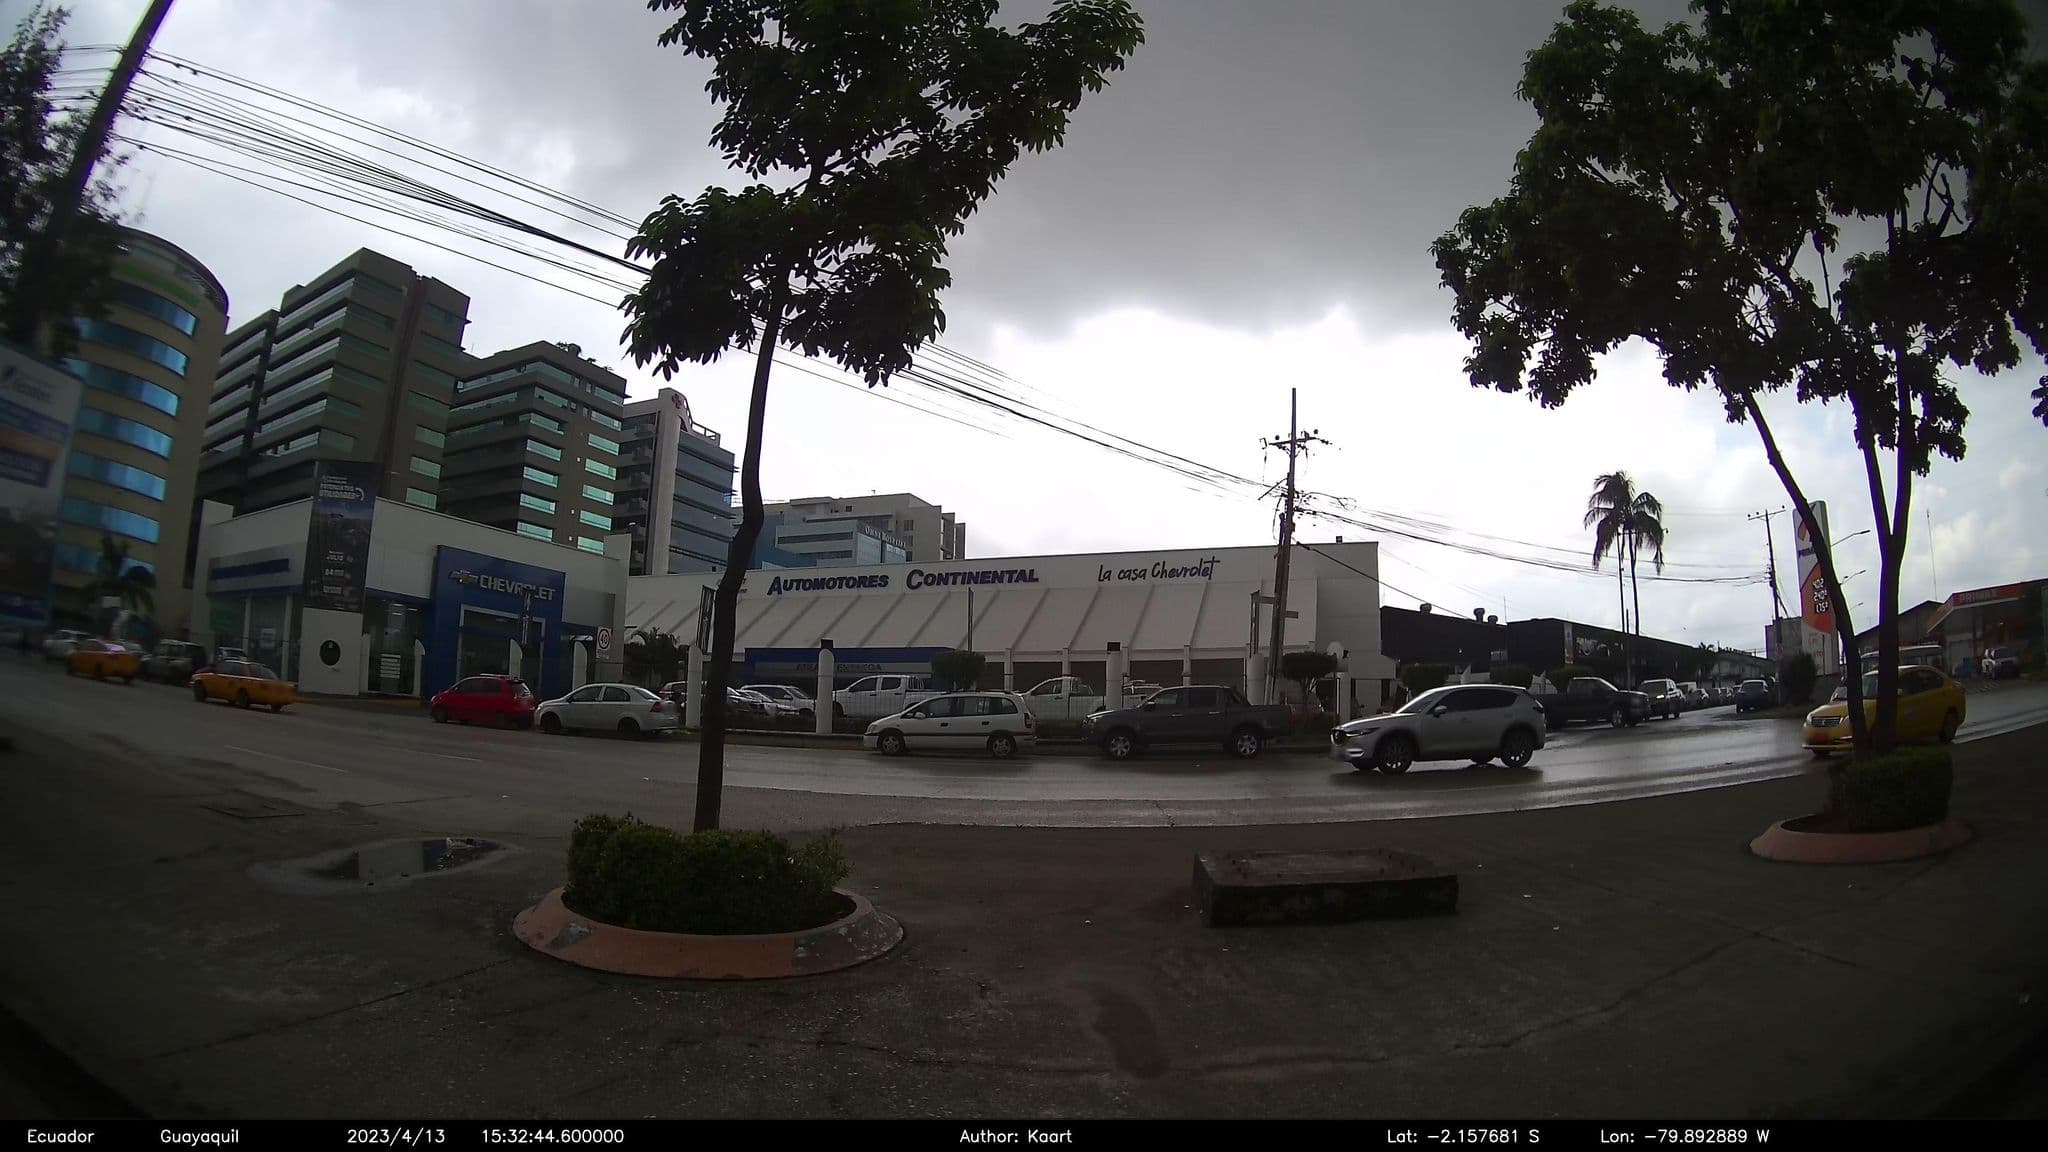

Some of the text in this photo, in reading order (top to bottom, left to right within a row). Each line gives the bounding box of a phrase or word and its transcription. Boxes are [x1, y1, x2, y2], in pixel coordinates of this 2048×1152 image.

[1098, 556, 1221, 582] La casa Chevrolet
[767, 574, 890, 596] AUTOMOTORES
[906, 569, 1040, 590] CONTINENTAL
